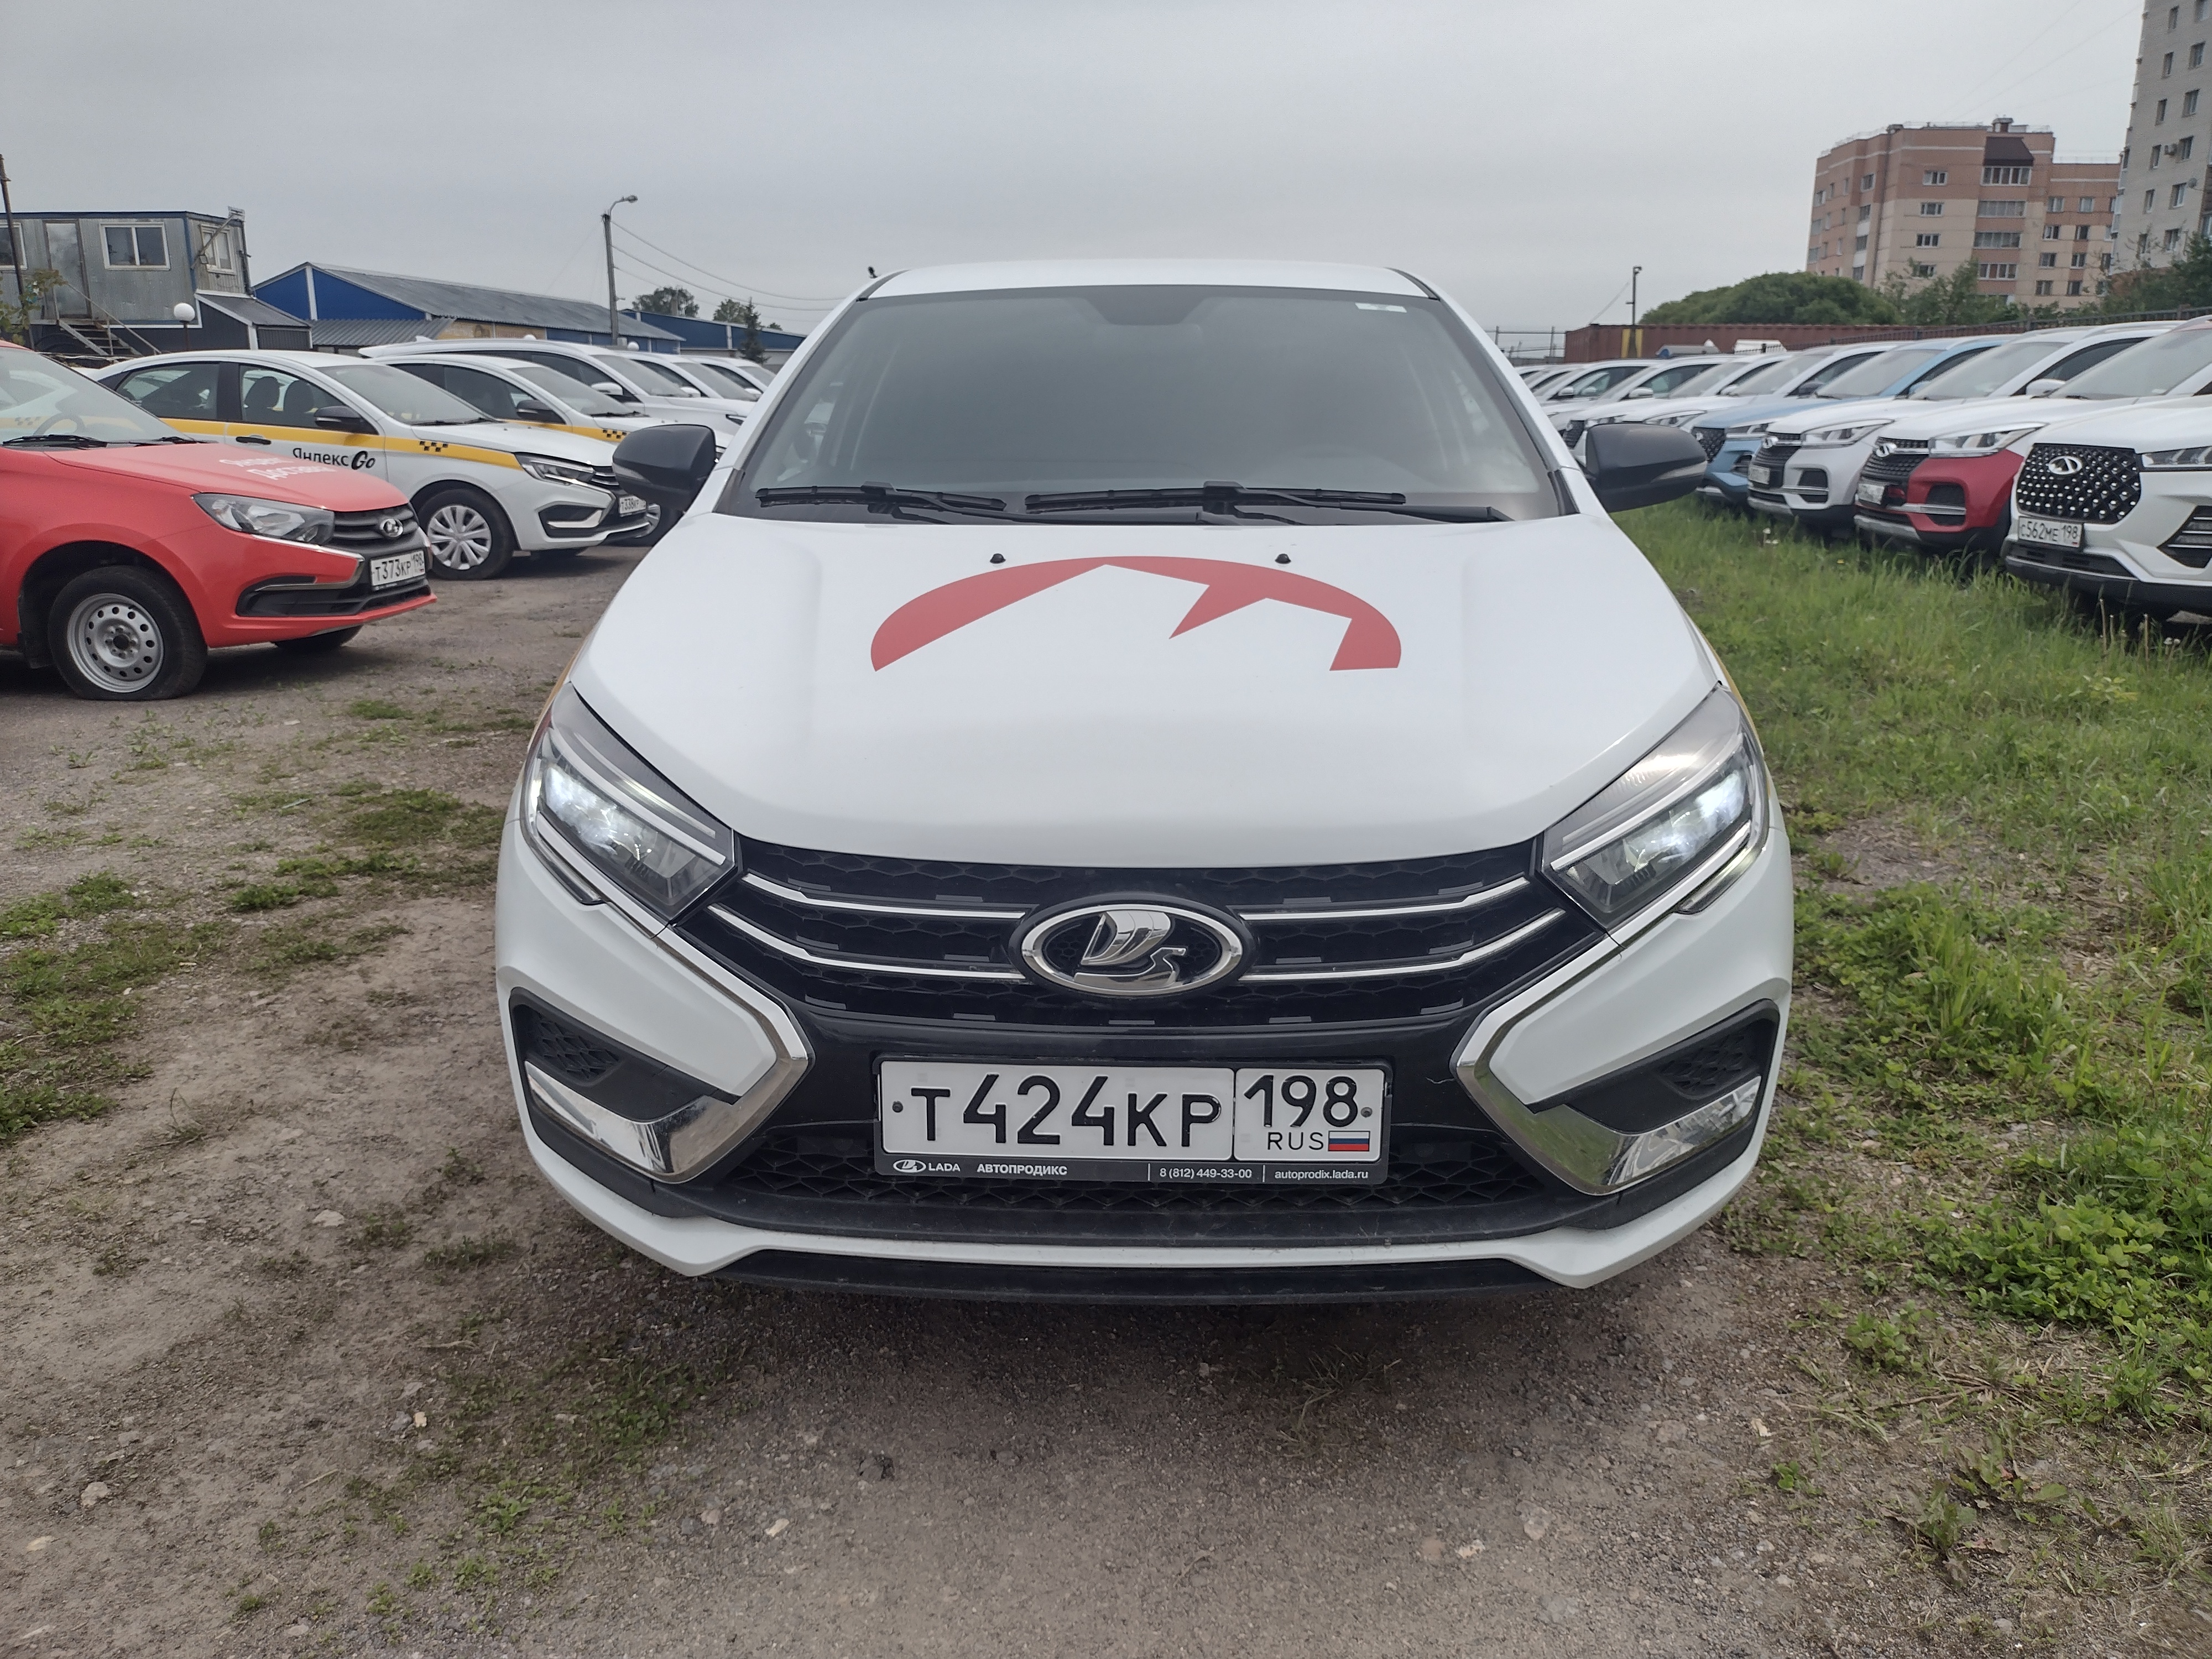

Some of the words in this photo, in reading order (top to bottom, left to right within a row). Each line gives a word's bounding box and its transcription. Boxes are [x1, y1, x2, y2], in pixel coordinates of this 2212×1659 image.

[293, 448, 349, 467] Яндекс
[351, 450, 376, 470] Go
[375, 559, 411, 582] Т373КР
[911, 1072, 1222, 1147] Т424КР
[1243, 1074, 1358, 1128] 198
[1267, 1131, 1324, 1150] RUS
[928, 1162, 961, 1172] LADA
[977, 1164, 1068, 1176] АВТОПРОДИКС
[1160, 1168, 1166, 1177] 8
[1169, 1168, 1194, 1178] (812)
[1197, 1168, 1252, 1178] 449-33-00
[1274, 1169, 1369, 1180] autoprodix.lada.ru
